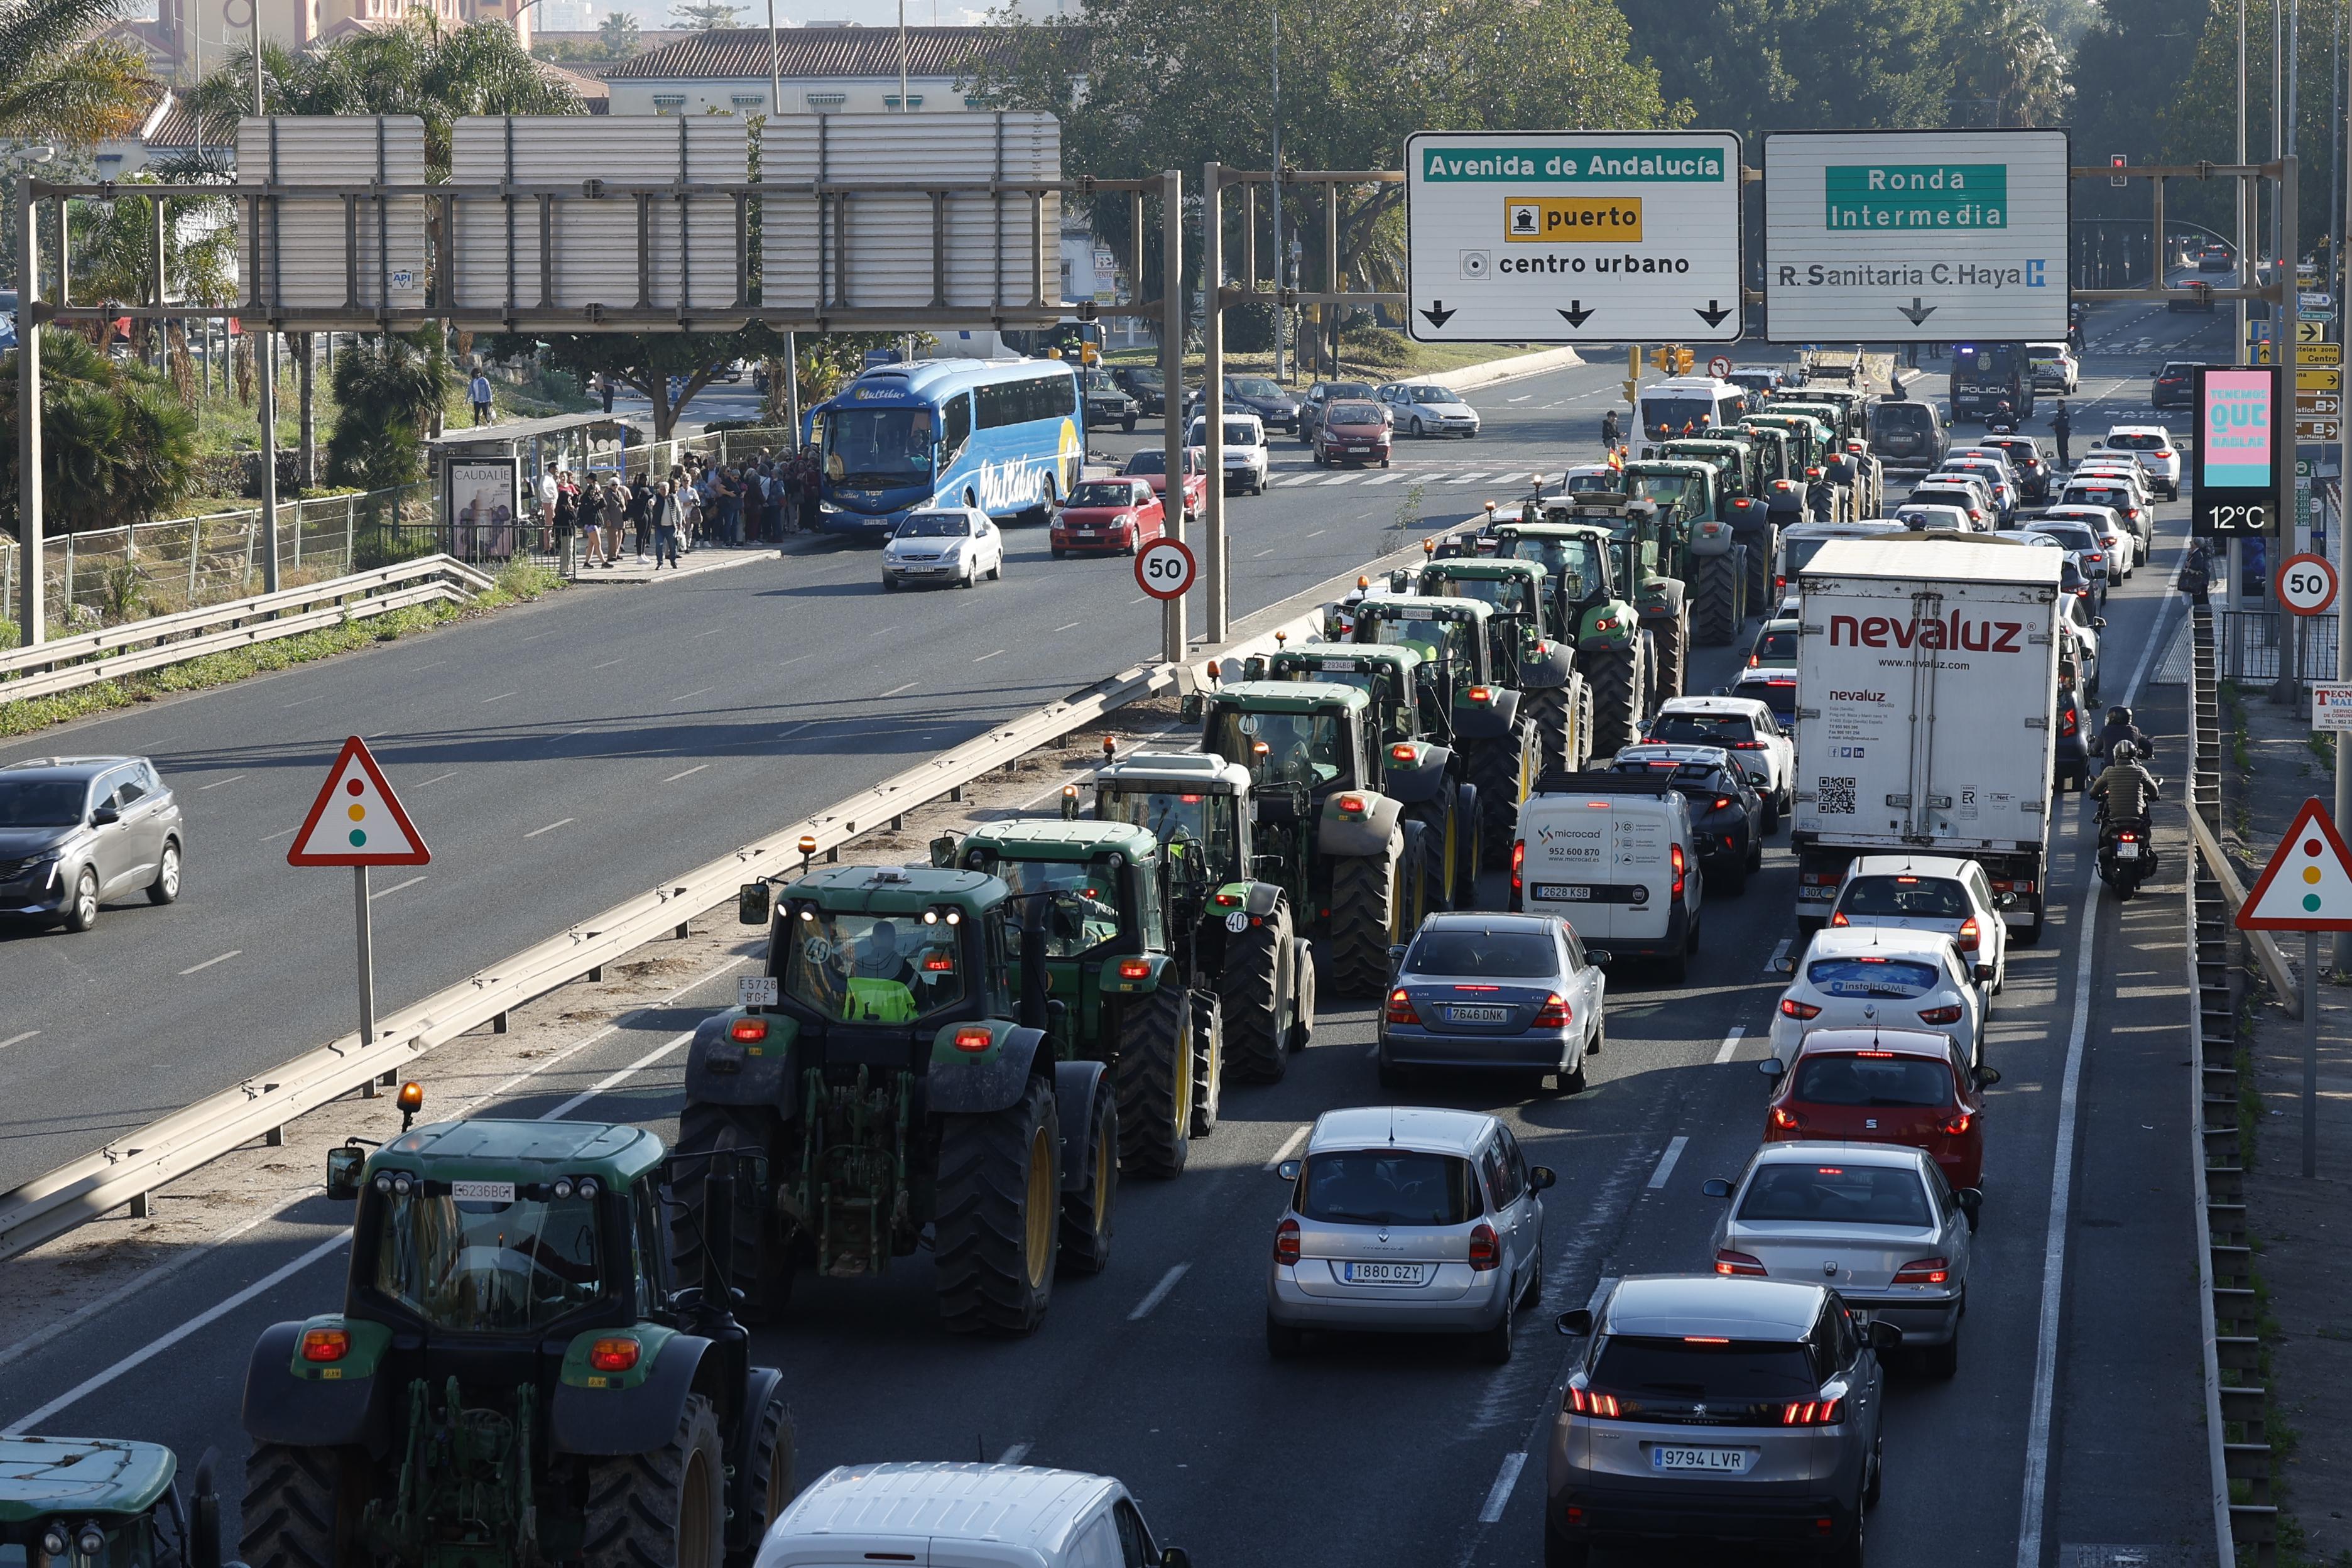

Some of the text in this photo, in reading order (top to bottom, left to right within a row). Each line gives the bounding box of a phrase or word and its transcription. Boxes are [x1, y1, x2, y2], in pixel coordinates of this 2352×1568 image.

[1429, 153, 1719, 176] Avenida de Andalucía
[1869, 169, 1964, 190] Ronda
[1548, 207, 1637, 230] puerto
[1832, 204, 2001, 226] Intermedia
[1500, 253, 1689, 273] centro urbano
[1779, 265, 1802, 285] R.
[1808, 263, 1924, 285] Sanitaria
[1960, 385, 2008, 394] POLICÍA
[2211, 389, 2267, 400] TENEMOS
[2211, 403, 2267, 433] QUE
[2211, 437, 2266, 448] HABLAR
[454, 468, 509, 480] CAUDALÍE
[977, 453, 1043, 512] Multibus
[2209, 506, 2265, 528] 12°C
[1149, 558, 1181, 579] 50
[2290, 574, 2322, 594] 50
[1830, 608, 2022, 653] nevaluz
[1878, 660, 1970, 670] www.nevaluz.com
[1829, 689, 1886, 702] nevaluz
[1243, 717, 1254, 732] 40
[1555, 829, 1600, 839] microcad
[1544, 888, 1588, 896] 2628 KSB
[1228, 914, 1244, 931] 40
[805, 943, 829, 959] 40
[1845, 982, 1907, 993] instalHOME
[1453, 1009, 1503, 1020] 7646 DNK
[454, 1184, 513, 1198] E6236BGT
[1357, 1265, 1419, 1278] 1880 GZY
[1665, 1451, 1741, 1467] 9794 LVR
